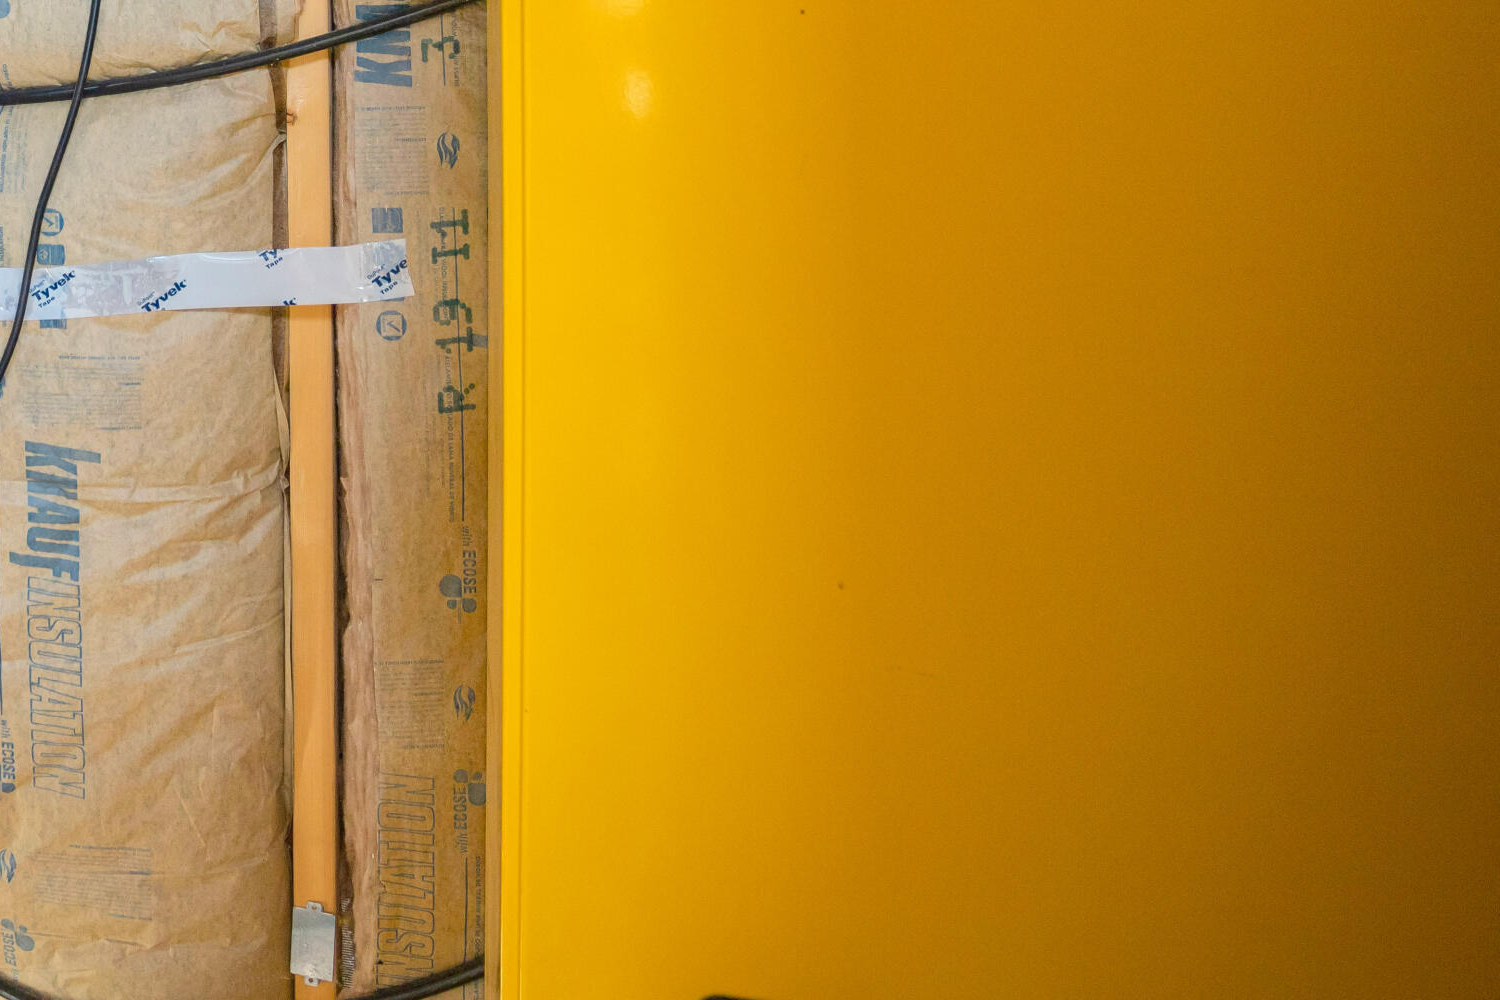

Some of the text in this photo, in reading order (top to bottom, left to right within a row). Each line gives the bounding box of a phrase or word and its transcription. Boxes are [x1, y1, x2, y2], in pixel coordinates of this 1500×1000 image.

[31, 270, 76, 302] Tyvek
[371, 258, 409, 288] Tyve
[141, 279, 188, 312] Tyvek
[463, 549, 478, 598] ECOSE
[9, 440, 100, 800] KNAUF INSULATION
[1, 743, 16, 780] ECOSE
[453, 785, 468, 830] ECOSE
